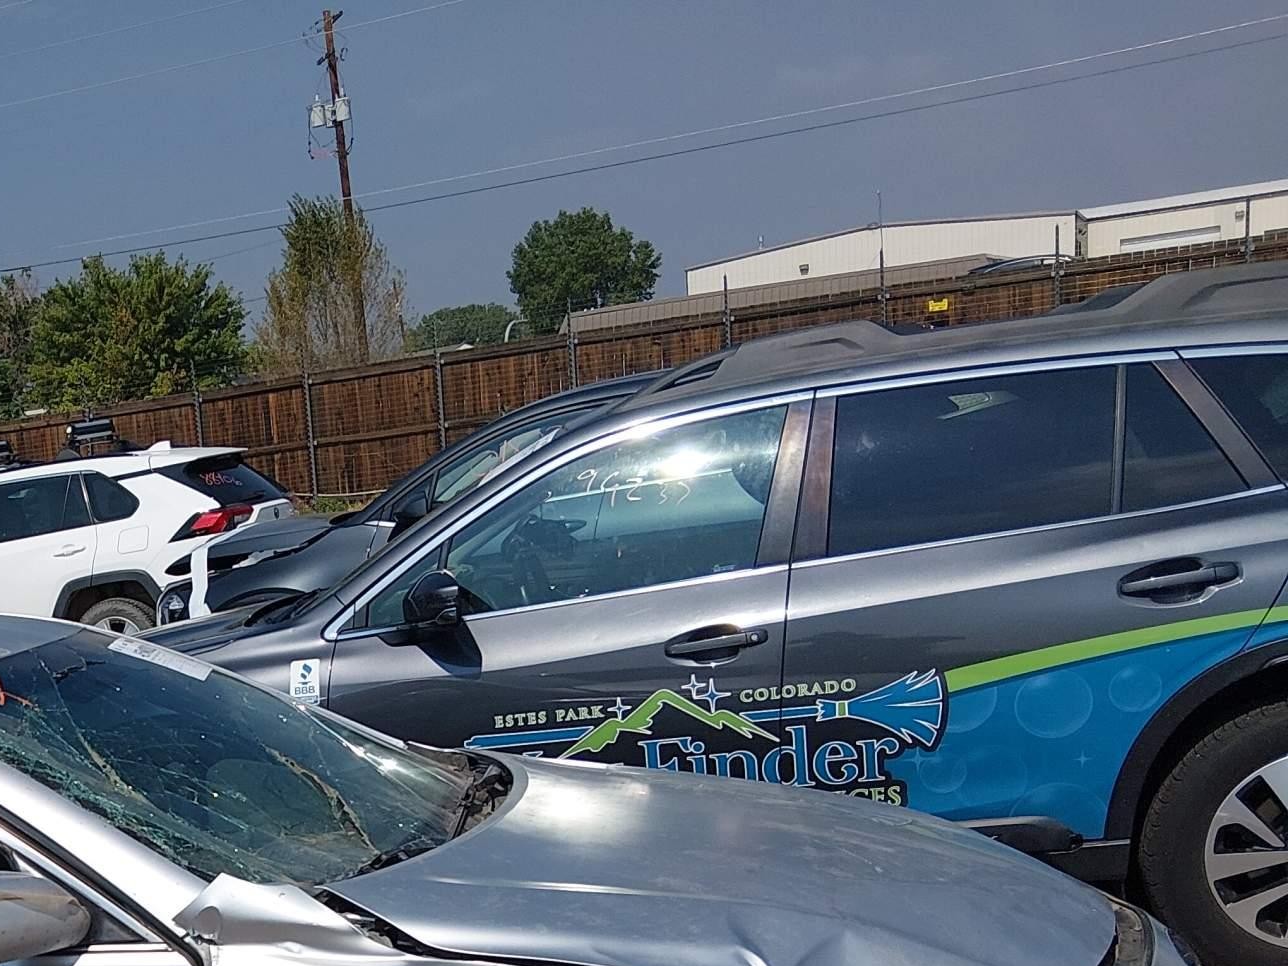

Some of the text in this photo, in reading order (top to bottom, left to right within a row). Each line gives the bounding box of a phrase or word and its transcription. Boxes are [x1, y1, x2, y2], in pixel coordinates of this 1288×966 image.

[294, 685, 316, 696] BBB
[739, 679, 857, 703] COLORADO
[494, 705, 606, 729] ESTES PARK
[638, 725, 900, 787] Finder
